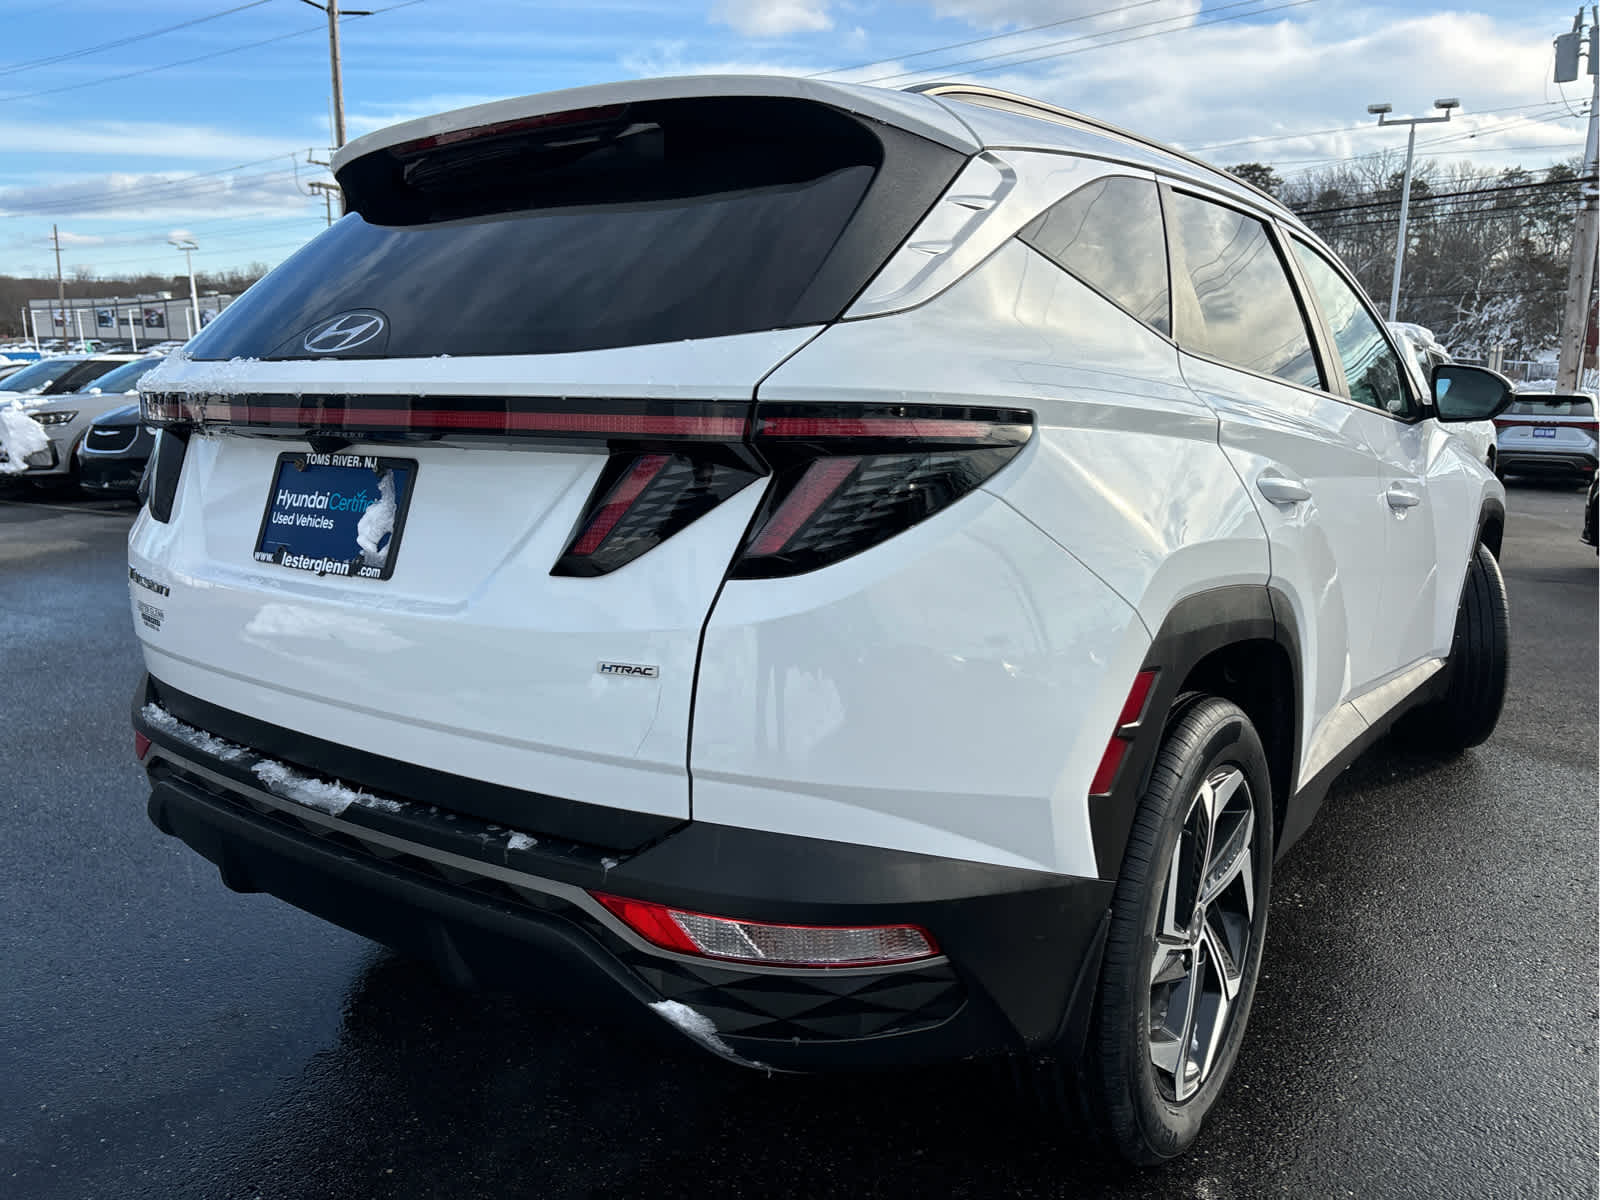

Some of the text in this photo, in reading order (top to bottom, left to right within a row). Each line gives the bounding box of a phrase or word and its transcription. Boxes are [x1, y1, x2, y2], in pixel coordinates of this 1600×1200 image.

[306, 453, 378, 469] TOMS RIVER, NJ
[276, 489, 330, 510] Hyundai
[272, 512, 335, 530] Used Vehicles
[254, 551, 381, 578] www. lesterglenn .com
[601, 664, 654, 676] HTRAC
